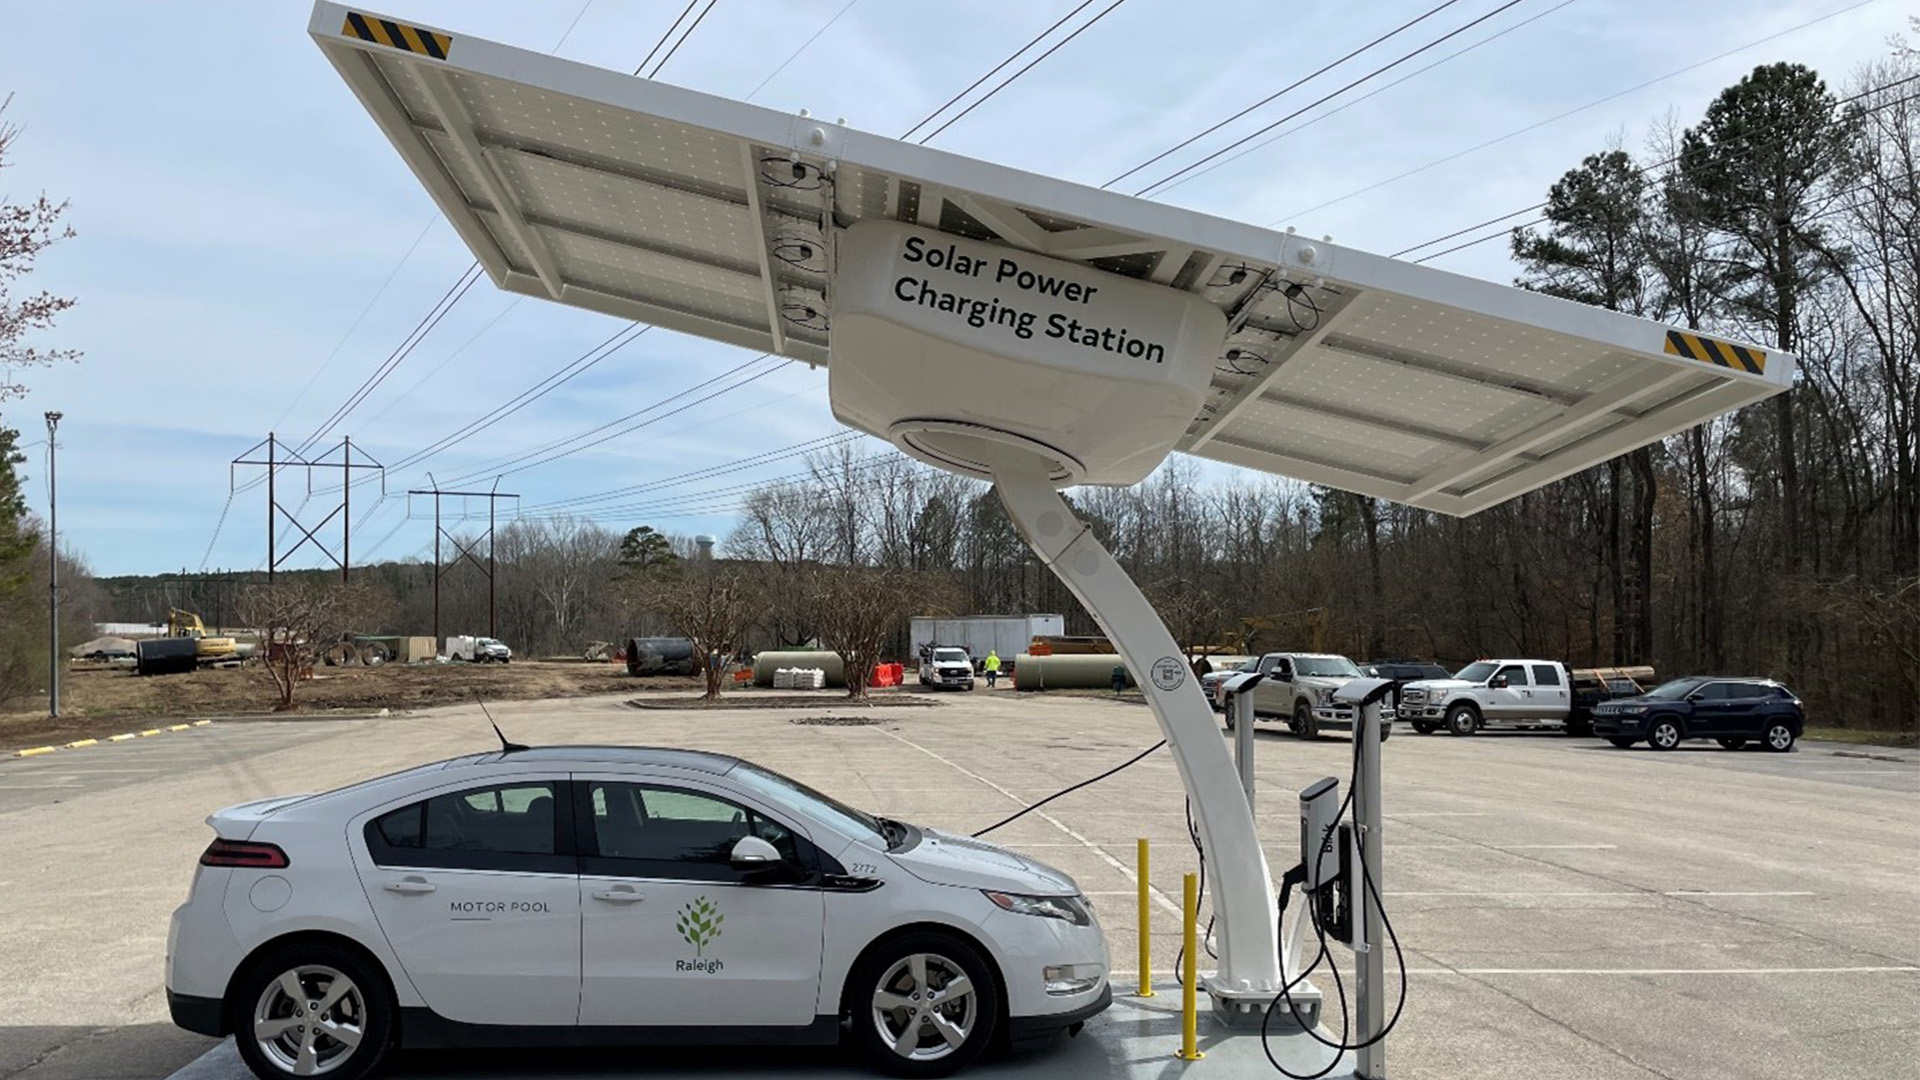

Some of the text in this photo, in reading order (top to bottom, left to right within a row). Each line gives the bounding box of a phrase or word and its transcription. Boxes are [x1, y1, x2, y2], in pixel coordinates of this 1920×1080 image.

[902, 236, 1099, 306] Solar Power
[894, 276, 1165, 364] Charging Station
[852, 862, 878, 874] 2772
[450, 901, 551, 913] MOTOR POOL
[675, 958, 724, 975] Raleigh
